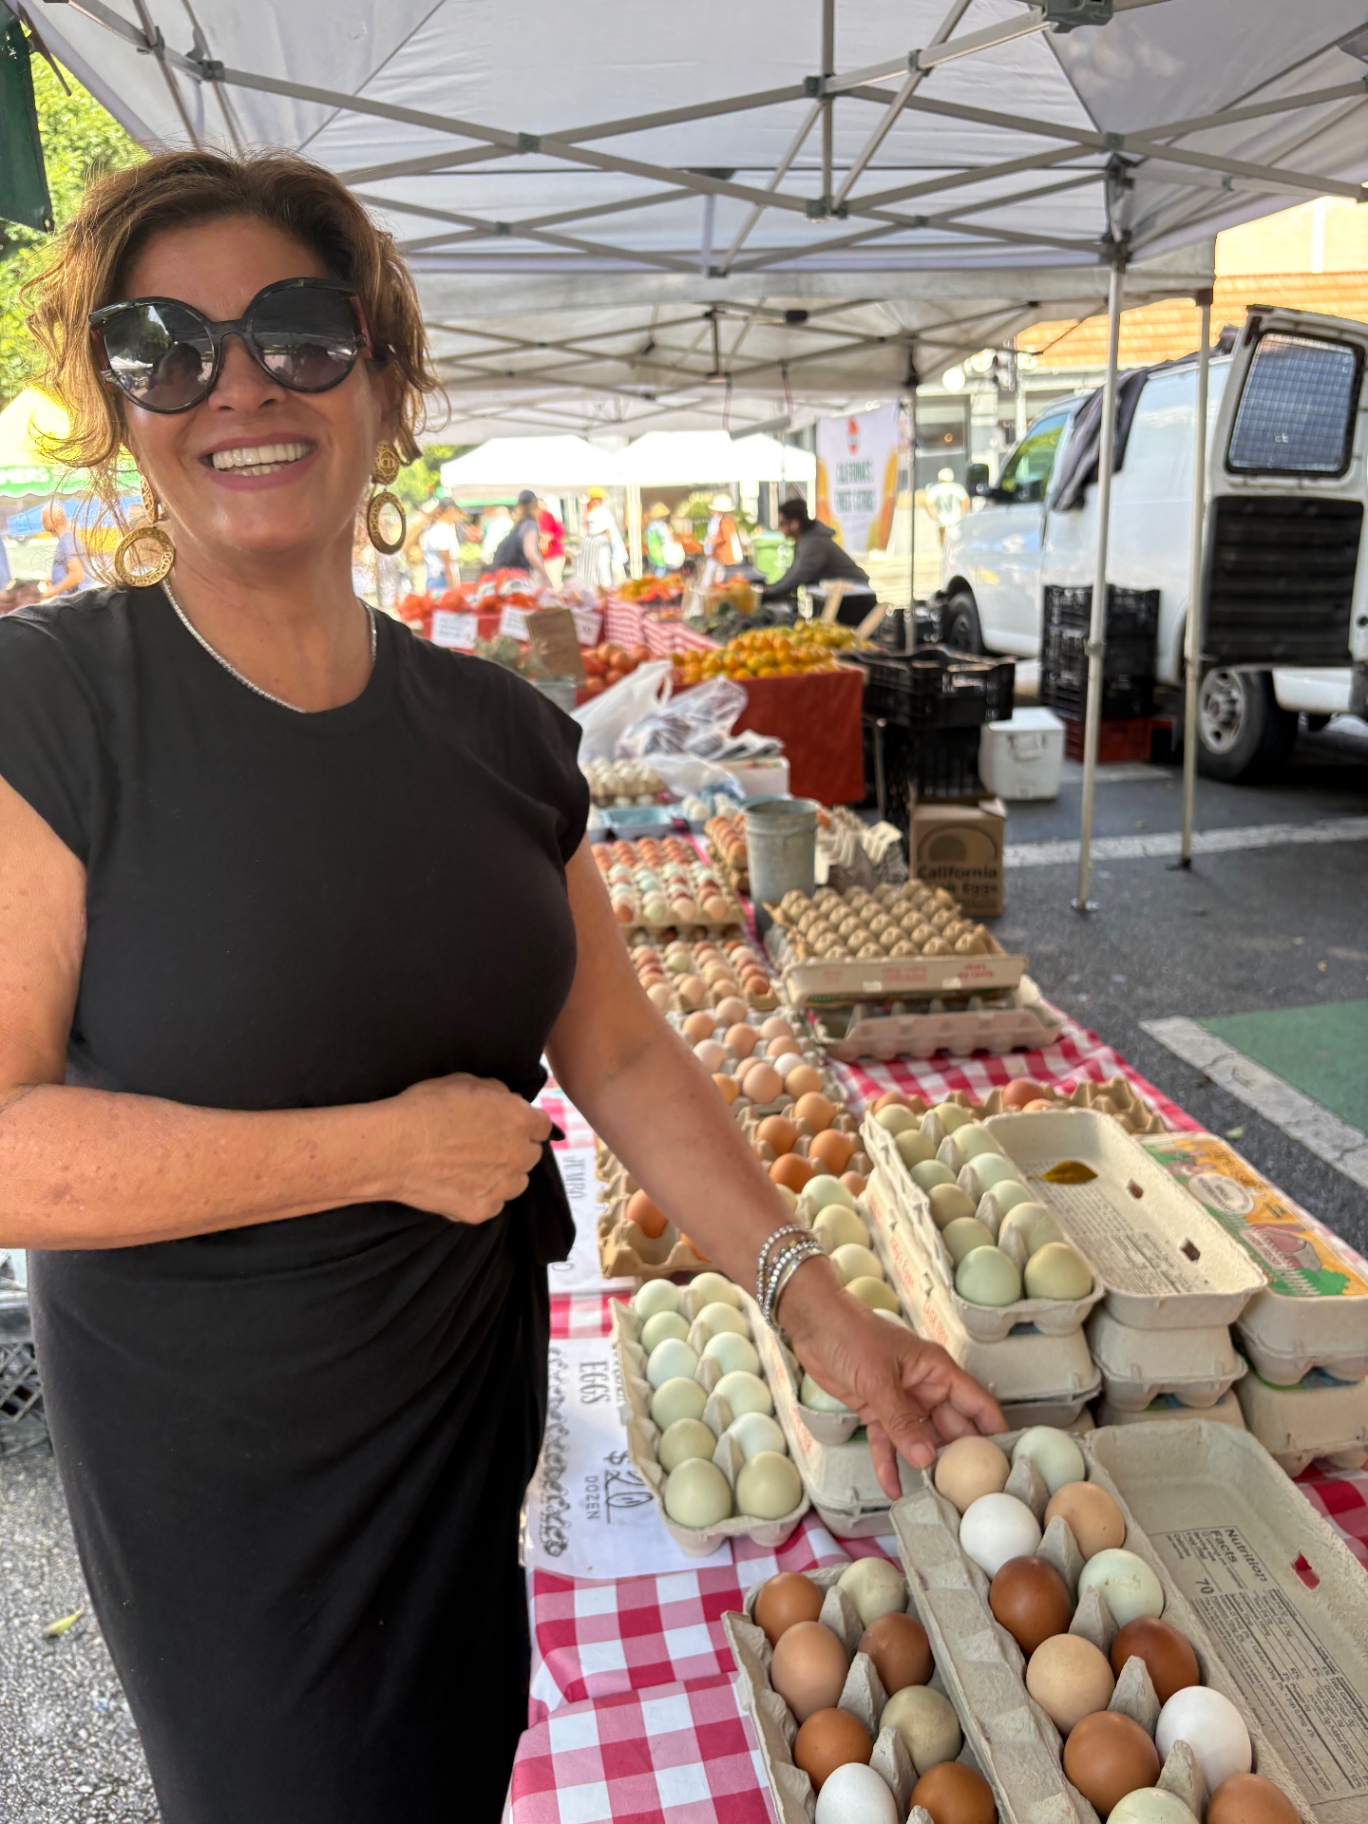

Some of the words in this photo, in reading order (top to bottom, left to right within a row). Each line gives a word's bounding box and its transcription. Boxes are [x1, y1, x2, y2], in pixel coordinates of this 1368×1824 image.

[917, 865, 997, 879] California
[563, 1155, 586, 1199] JUMBO
[579, 1359, 611, 1405] EGGS
[585, 1475, 601, 1520] DOZEN
[1209, 1530, 1240, 1563] Facts
[1223, 1528, 1270, 1582] Nutrition
[1193, 1578, 1215, 1595] 70
